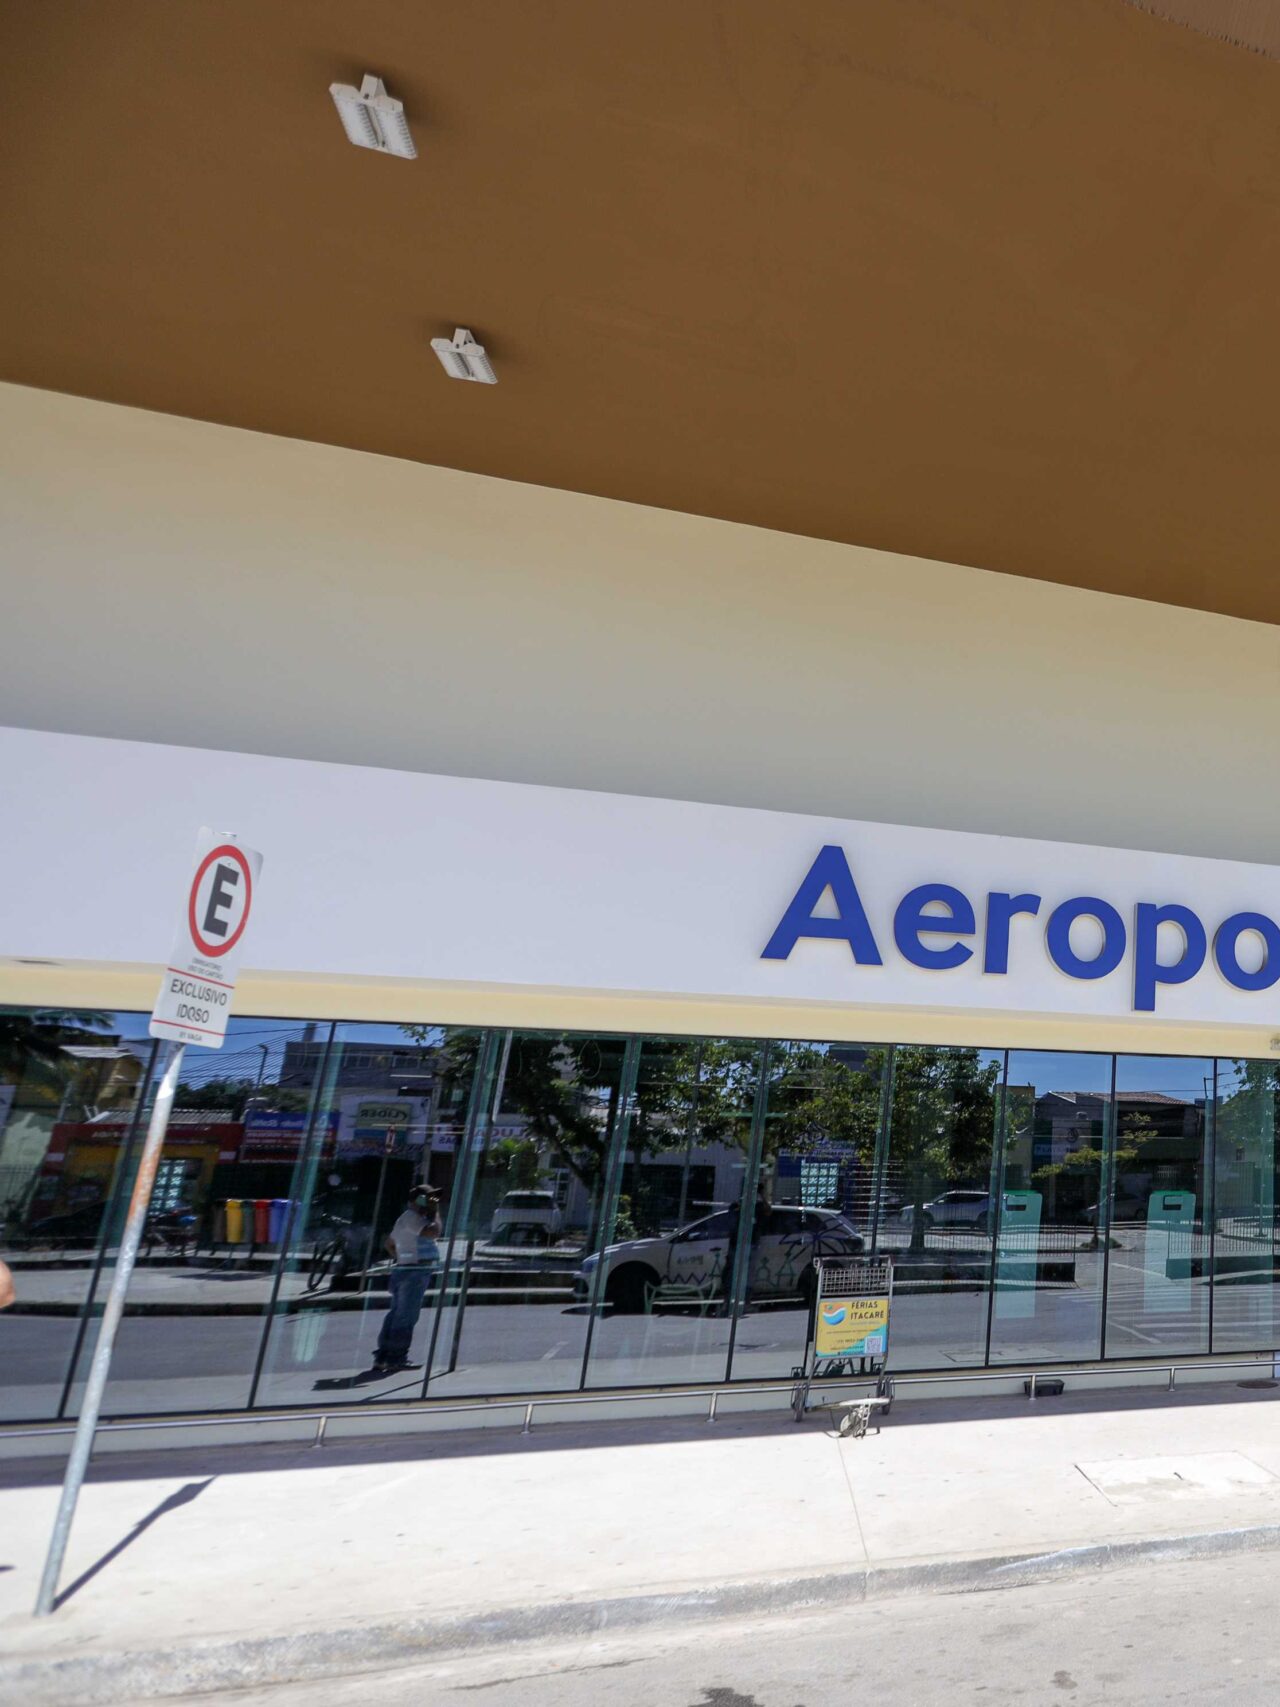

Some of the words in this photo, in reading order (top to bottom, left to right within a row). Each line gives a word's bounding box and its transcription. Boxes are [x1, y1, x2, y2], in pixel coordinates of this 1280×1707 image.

[203, 863, 240, 938] E
[170, 978, 228, 1006] EXCLUSIVO
[176, 1003, 210, 1023] IDOSO
[850, 1310, 885, 1320] ITACARÉ
[851, 1300, 878, 1310] FÉRIAS
